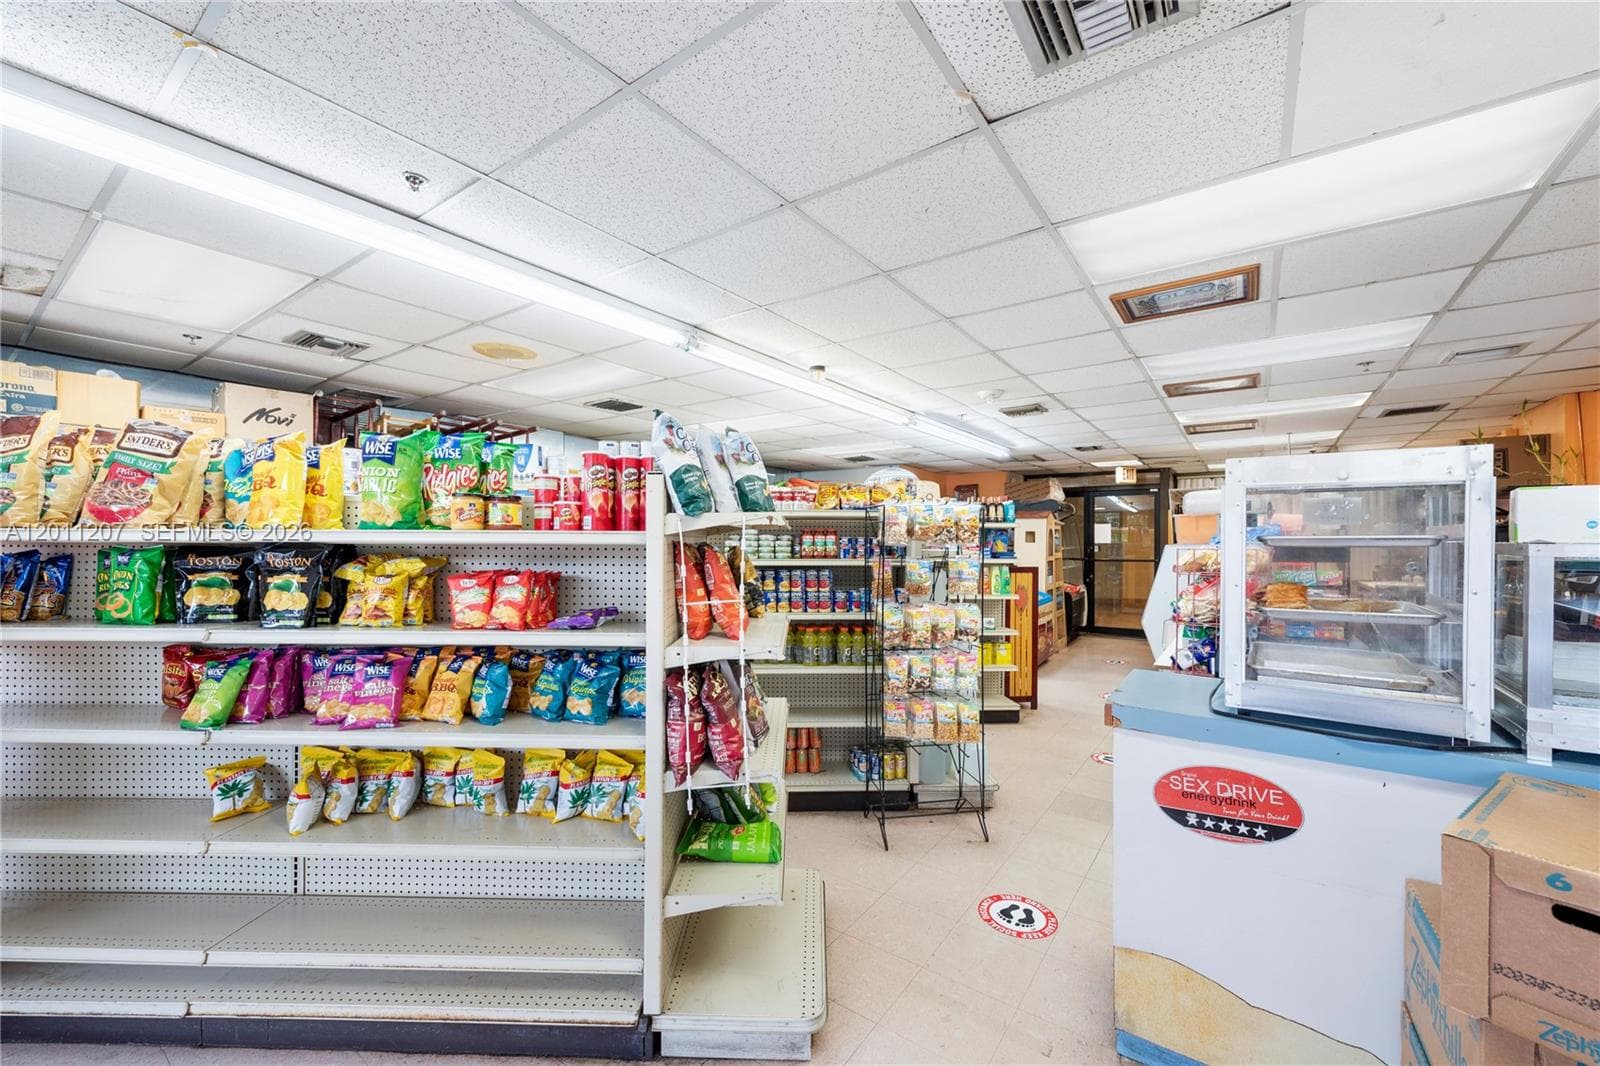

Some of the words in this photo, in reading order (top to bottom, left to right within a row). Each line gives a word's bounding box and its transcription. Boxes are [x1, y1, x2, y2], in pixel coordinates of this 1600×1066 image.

[0, 382, 34, 392] rona
[365, 440, 394, 455] WISE
[434, 447, 462, 459] WISE
[423, 463, 479, 497] Ridgies
[366, 665, 391, 675] WISE
[354, 687, 399, 698] vinegar
[432, 682, 457, 693] BBQ
[1169, 775, 1210, 796] SEX
[1216, 781, 1285, 806] DRIVE
[1181, 790, 1257, 809] energydrink
[1546, 873, 1573, 893] 6
[1024, 898, 1050, 914] STAND
[988, 920, 1018, 938] SOCIAL
[1020, 932, 1044, 940] KEEP
